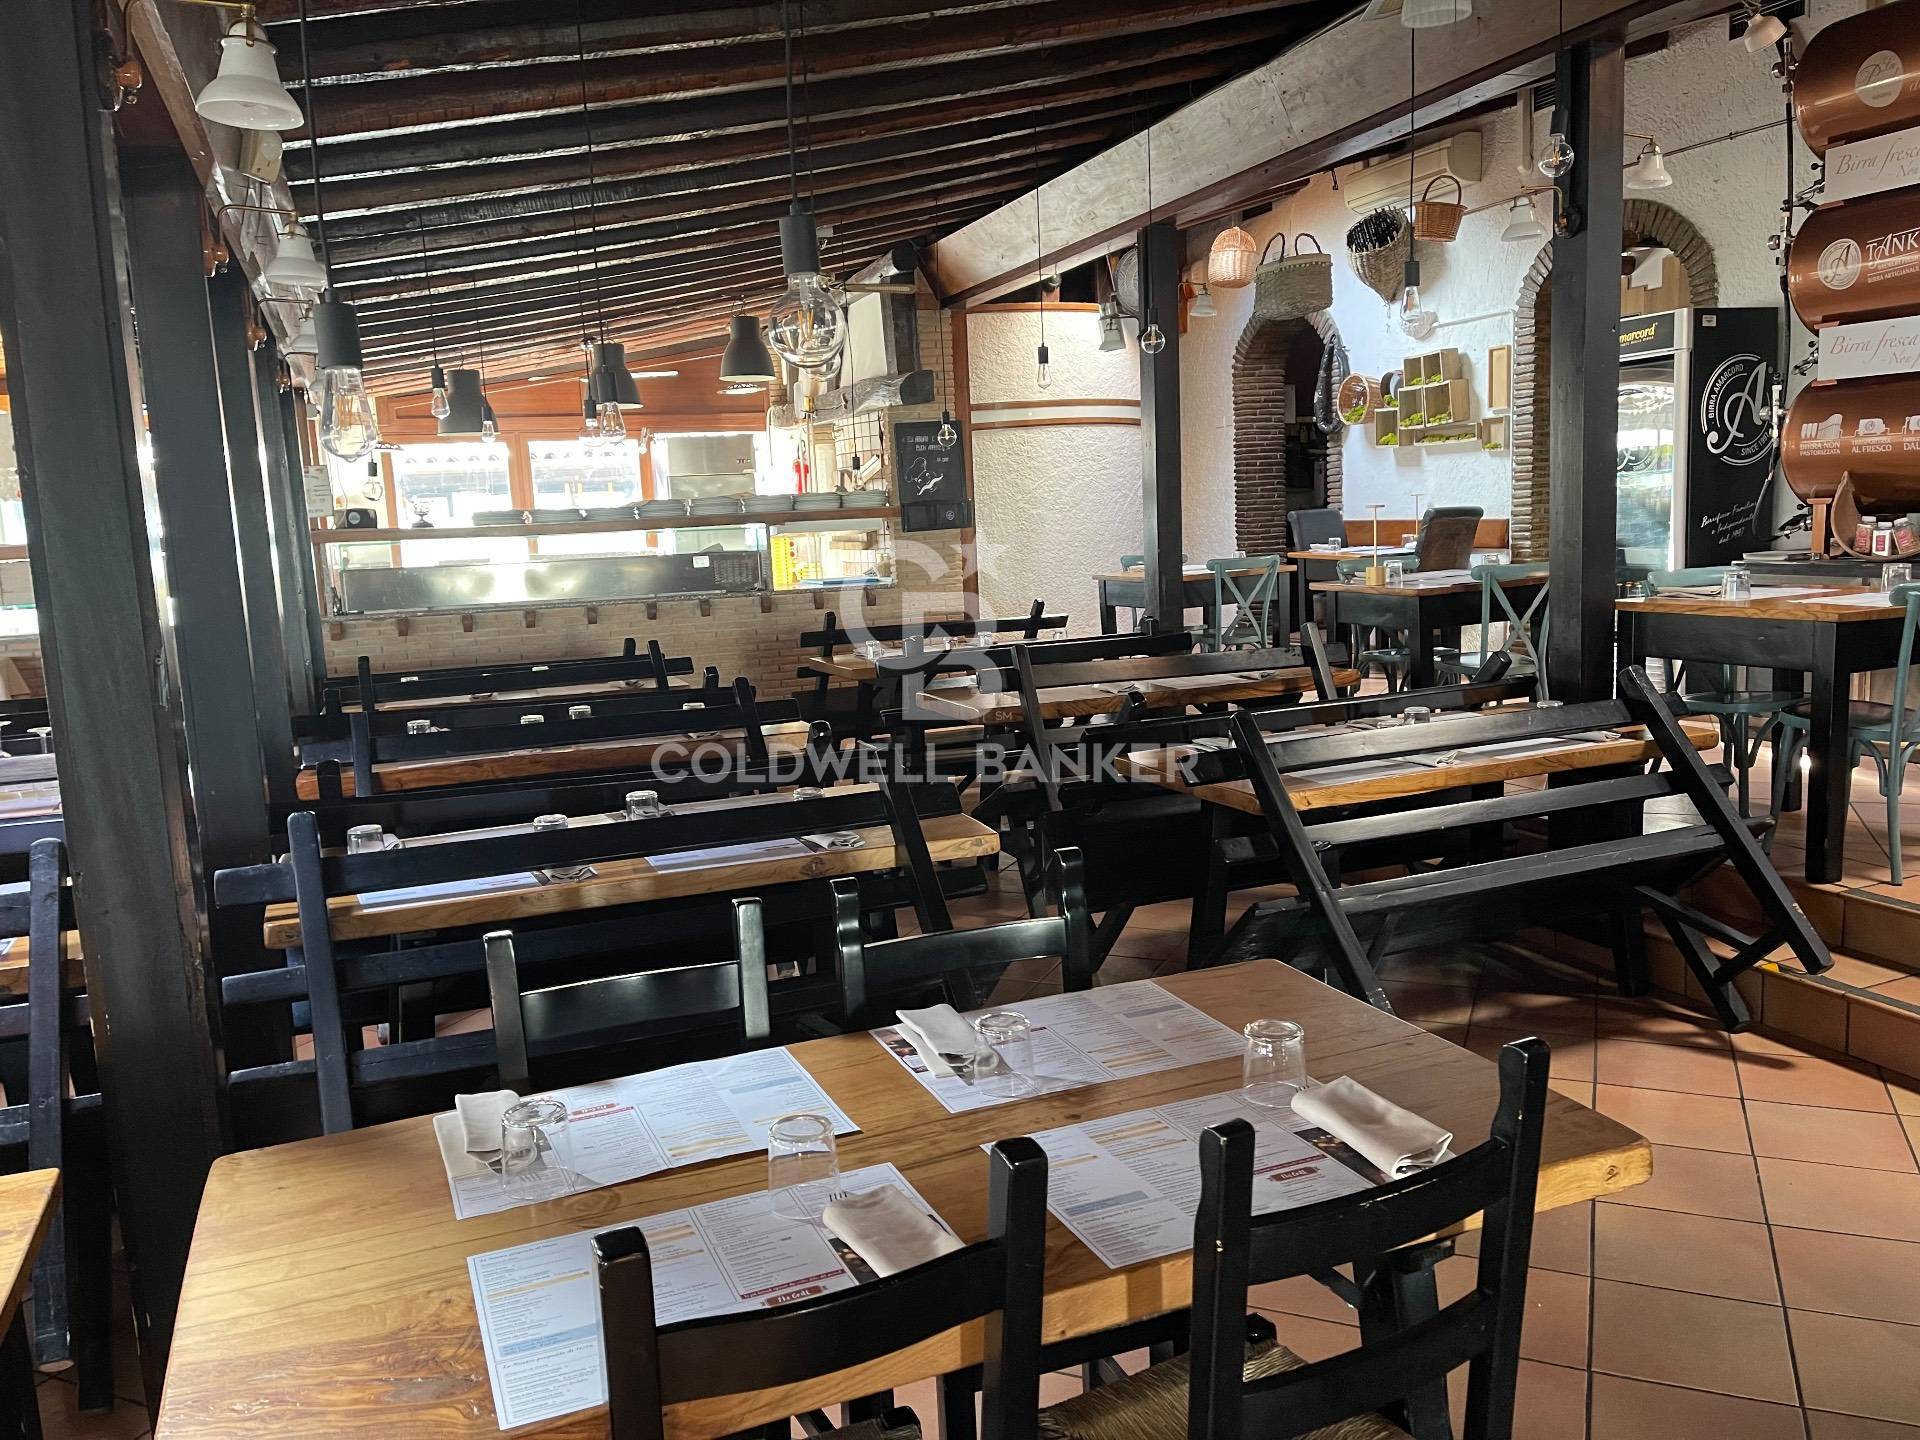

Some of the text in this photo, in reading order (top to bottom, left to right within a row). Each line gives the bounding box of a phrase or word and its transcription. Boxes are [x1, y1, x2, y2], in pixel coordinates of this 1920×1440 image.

[1865, 231, 1920, 262] TANK
[1619, 321, 1656, 344] marcord
[1708, 363, 1744, 419] BIRRA AMARCORD
[1740, 442, 1760, 456] SINCE
[1862, 443, 1893, 453] FRESCO
